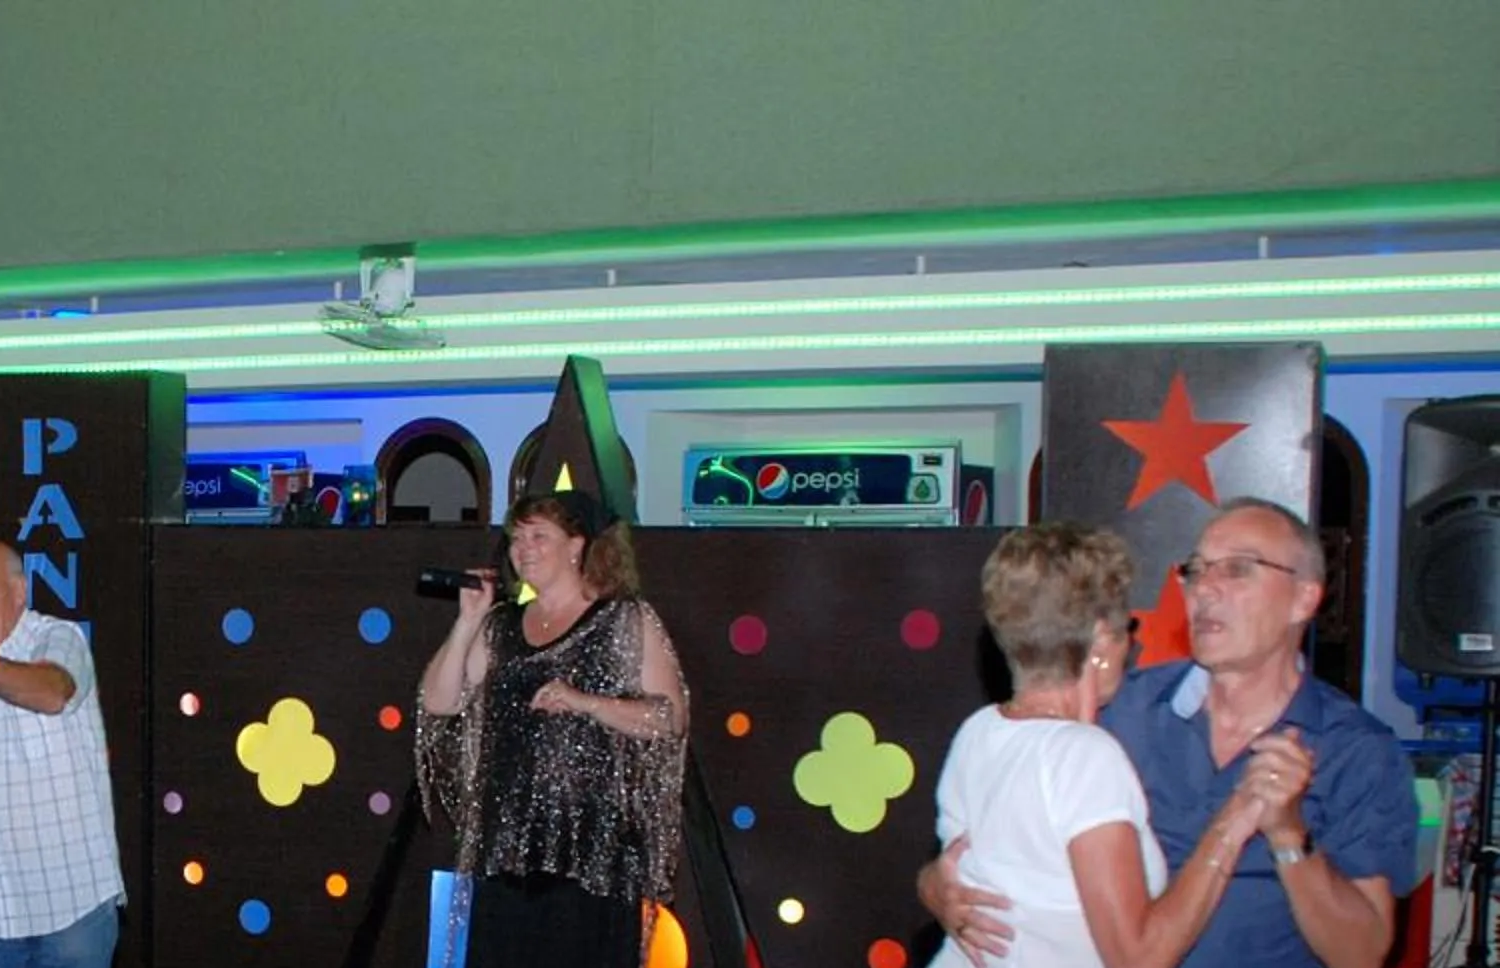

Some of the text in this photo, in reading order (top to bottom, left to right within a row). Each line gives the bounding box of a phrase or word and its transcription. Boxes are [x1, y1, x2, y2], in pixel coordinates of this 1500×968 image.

[184, 476, 221, 498] epsi
[791, 468, 860, 493] pepsi
[17, 417, 92, 641] PAN
